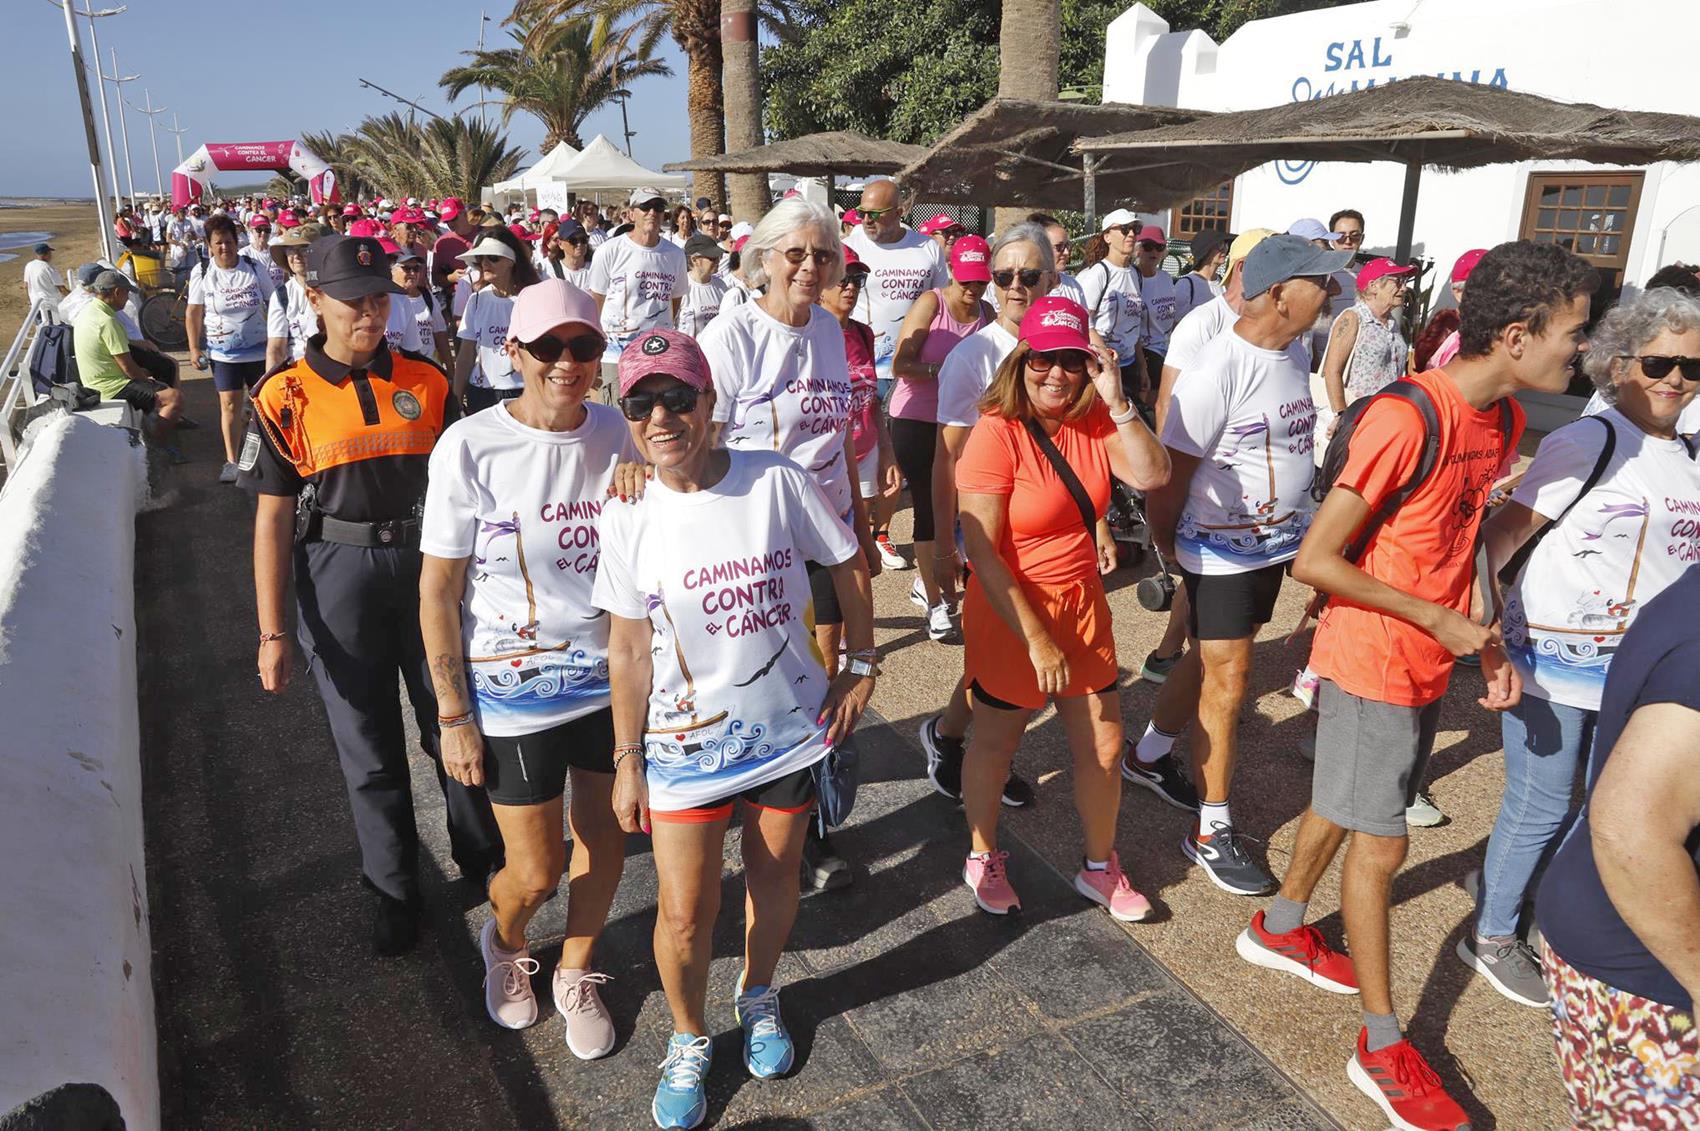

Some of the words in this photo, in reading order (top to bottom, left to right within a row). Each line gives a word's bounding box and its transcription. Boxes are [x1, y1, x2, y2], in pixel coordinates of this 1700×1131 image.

[1324, 36, 1393, 72] SAL
[634, 271, 676, 282] CAMINAMOS
[875, 268, 932, 278] CAMINAMOS
[881, 279, 925, 289] CONTRA
[786, 378, 852, 394] CAMINAMOS
[1279, 397, 1314, 419] CAMINA
[800, 421, 810, 431] EL
[1288, 414, 1317, 437] CONT
[540, 500, 601, 522] CAMIN
[1665, 497, 1700, 516] CAMIN
[558, 526, 600, 550] CON
[1671, 518, 1700, 539] CON
[556, 557, 572, 570] EL
[684, 548, 792, 590] CAMINAMOS
[702, 576, 785, 615] CONTRA
[705, 622, 722, 636] EL
[726, 602, 791, 638] CÁNCER
